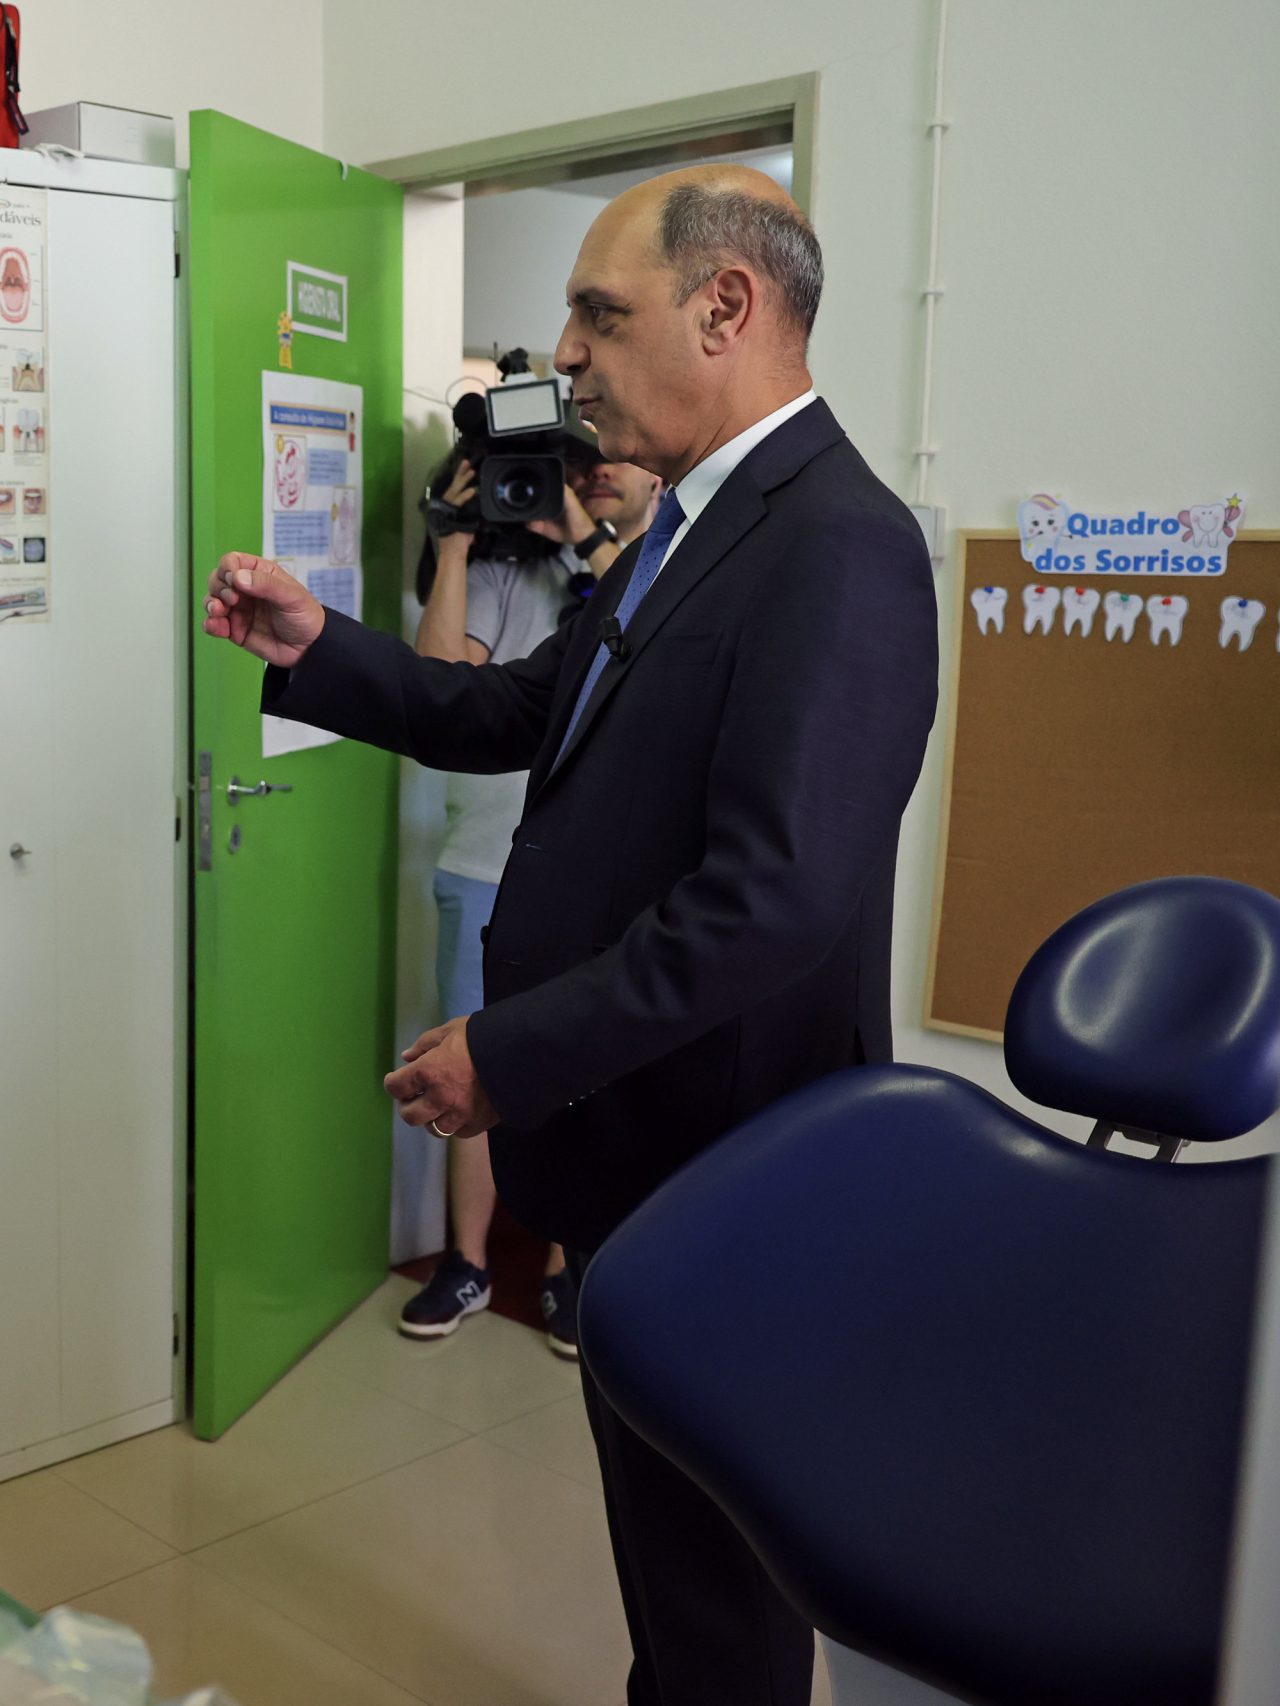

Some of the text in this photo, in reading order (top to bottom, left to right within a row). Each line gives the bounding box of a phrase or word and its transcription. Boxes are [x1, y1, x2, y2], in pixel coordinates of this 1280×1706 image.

[1067, 511, 1180, 538] Quadro
[1035, 548, 1222, 574] dos Sorrisos
